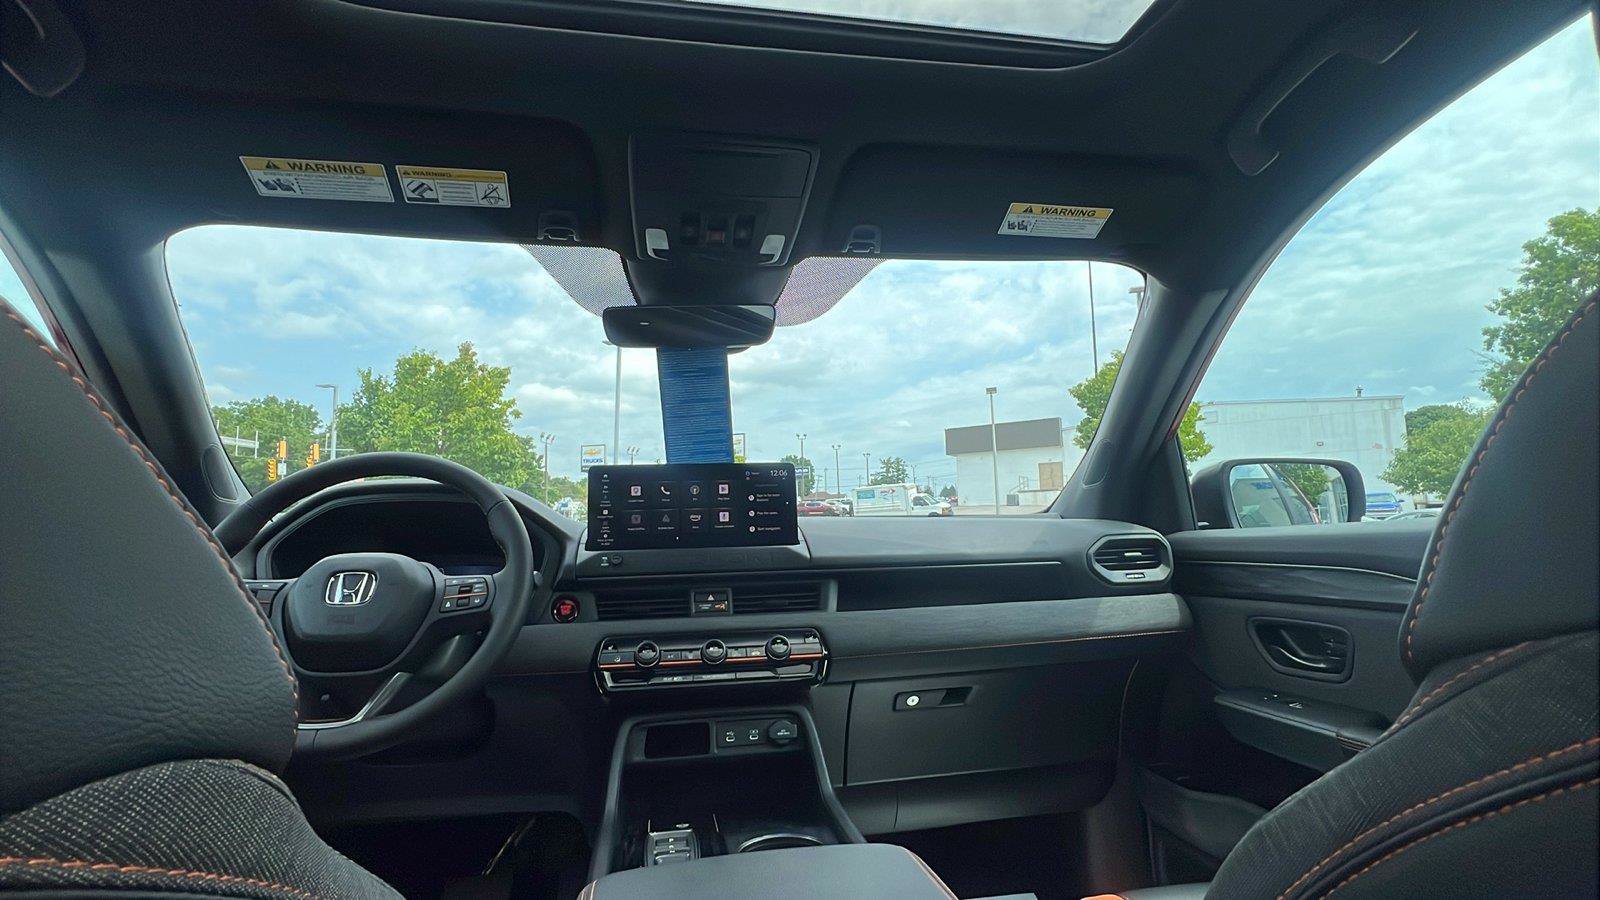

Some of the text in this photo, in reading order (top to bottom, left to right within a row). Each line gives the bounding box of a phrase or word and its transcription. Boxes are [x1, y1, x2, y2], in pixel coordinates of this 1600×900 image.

[287, 161, 366, 175] WARNING
[413, 170, 452, 178] WARNING
[1041, 206, 1097, 217] WARNING
